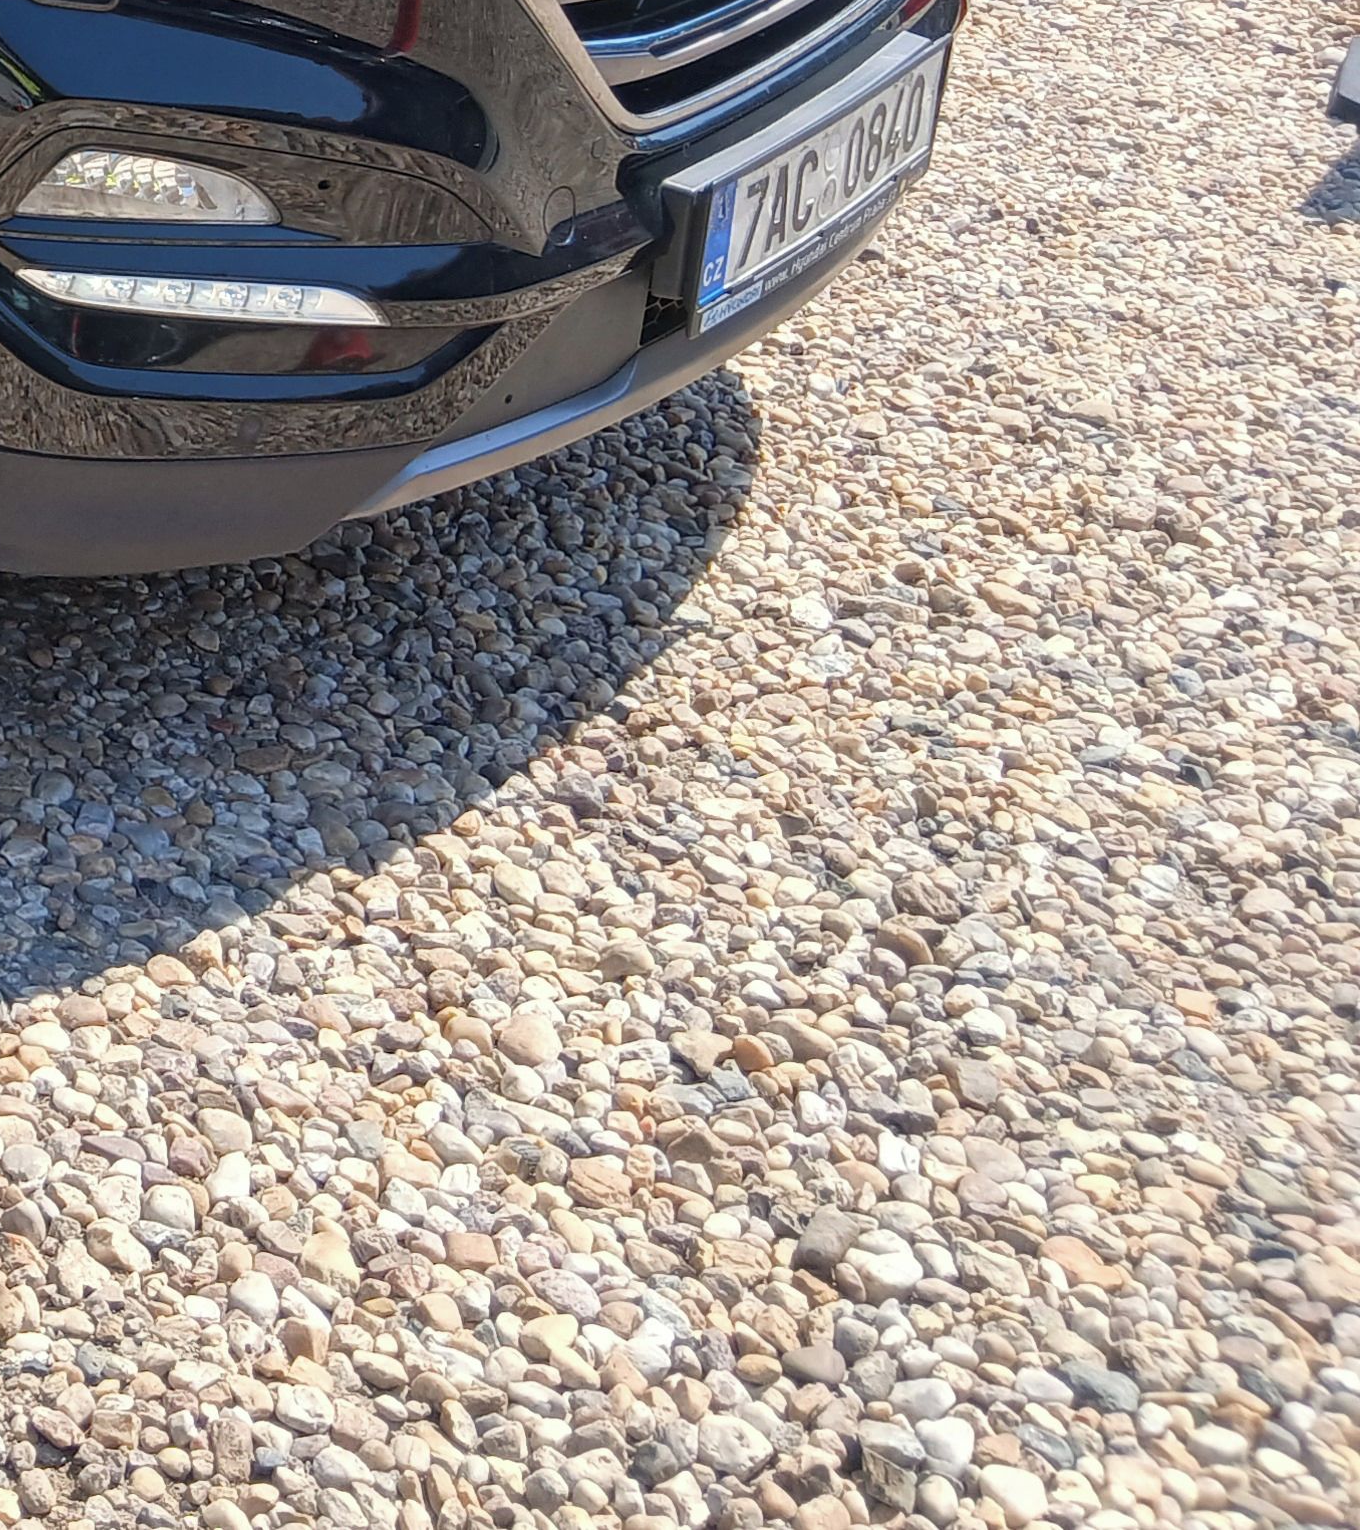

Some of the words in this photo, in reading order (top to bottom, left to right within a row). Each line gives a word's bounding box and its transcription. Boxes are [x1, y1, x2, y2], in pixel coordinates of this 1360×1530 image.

[735, 150, 818, 271] 7AC
[843, 72, 925, 198] 0840
[703, 256, 724, 287] CZ
